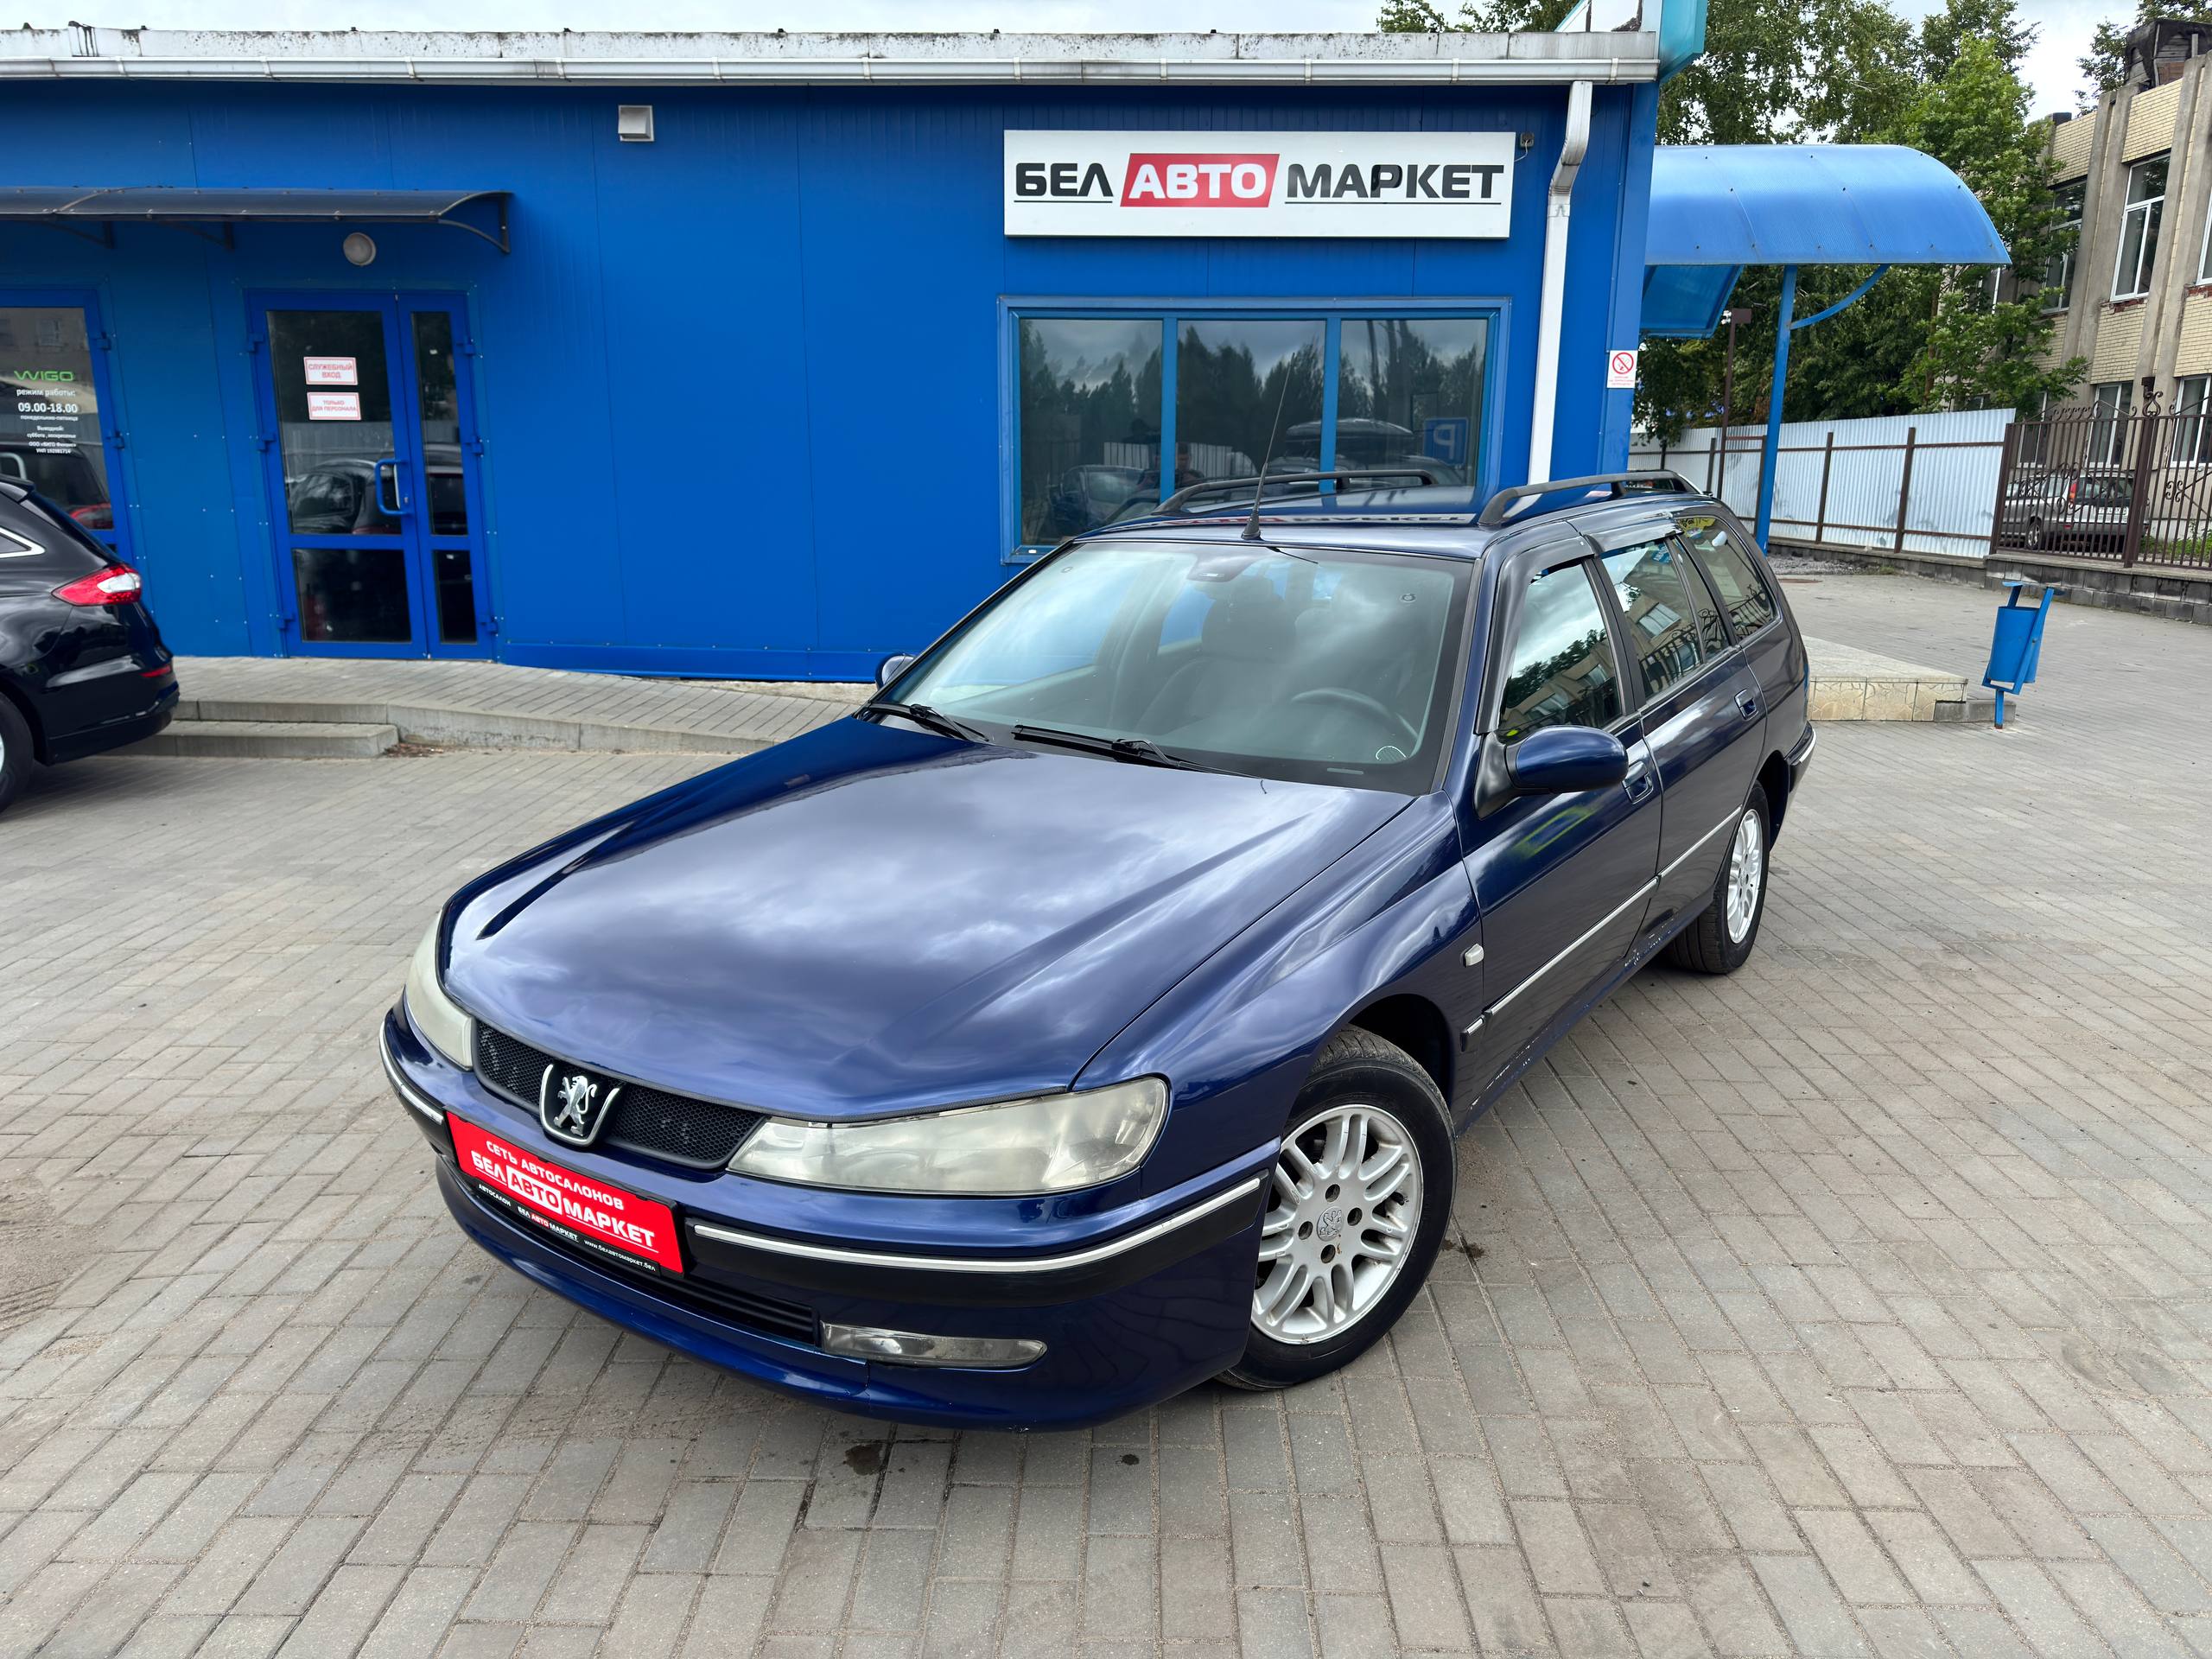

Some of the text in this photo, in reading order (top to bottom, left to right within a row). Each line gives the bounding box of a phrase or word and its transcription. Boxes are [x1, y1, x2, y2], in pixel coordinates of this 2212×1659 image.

[1015, 162, 1504, 200] БЕЛ АВТО МАРКЕТ
[14, 370, 73, 381] WIGO
[17, 402, 78, 413] 09.00-18.00
[45, 389, 76, 397] работы:
[486, 1141, 624, 1211] СЕТЬ АВТОСАЛОНОВ
[471, 1150, 655, 1247] БЕЛ АВТО МАРКЕТ
[479, 1184, 512, 1207] АВТОСАЛОН
[518, 1206, 578, 1241] БЕЛ АВТО МАРКЕТ
